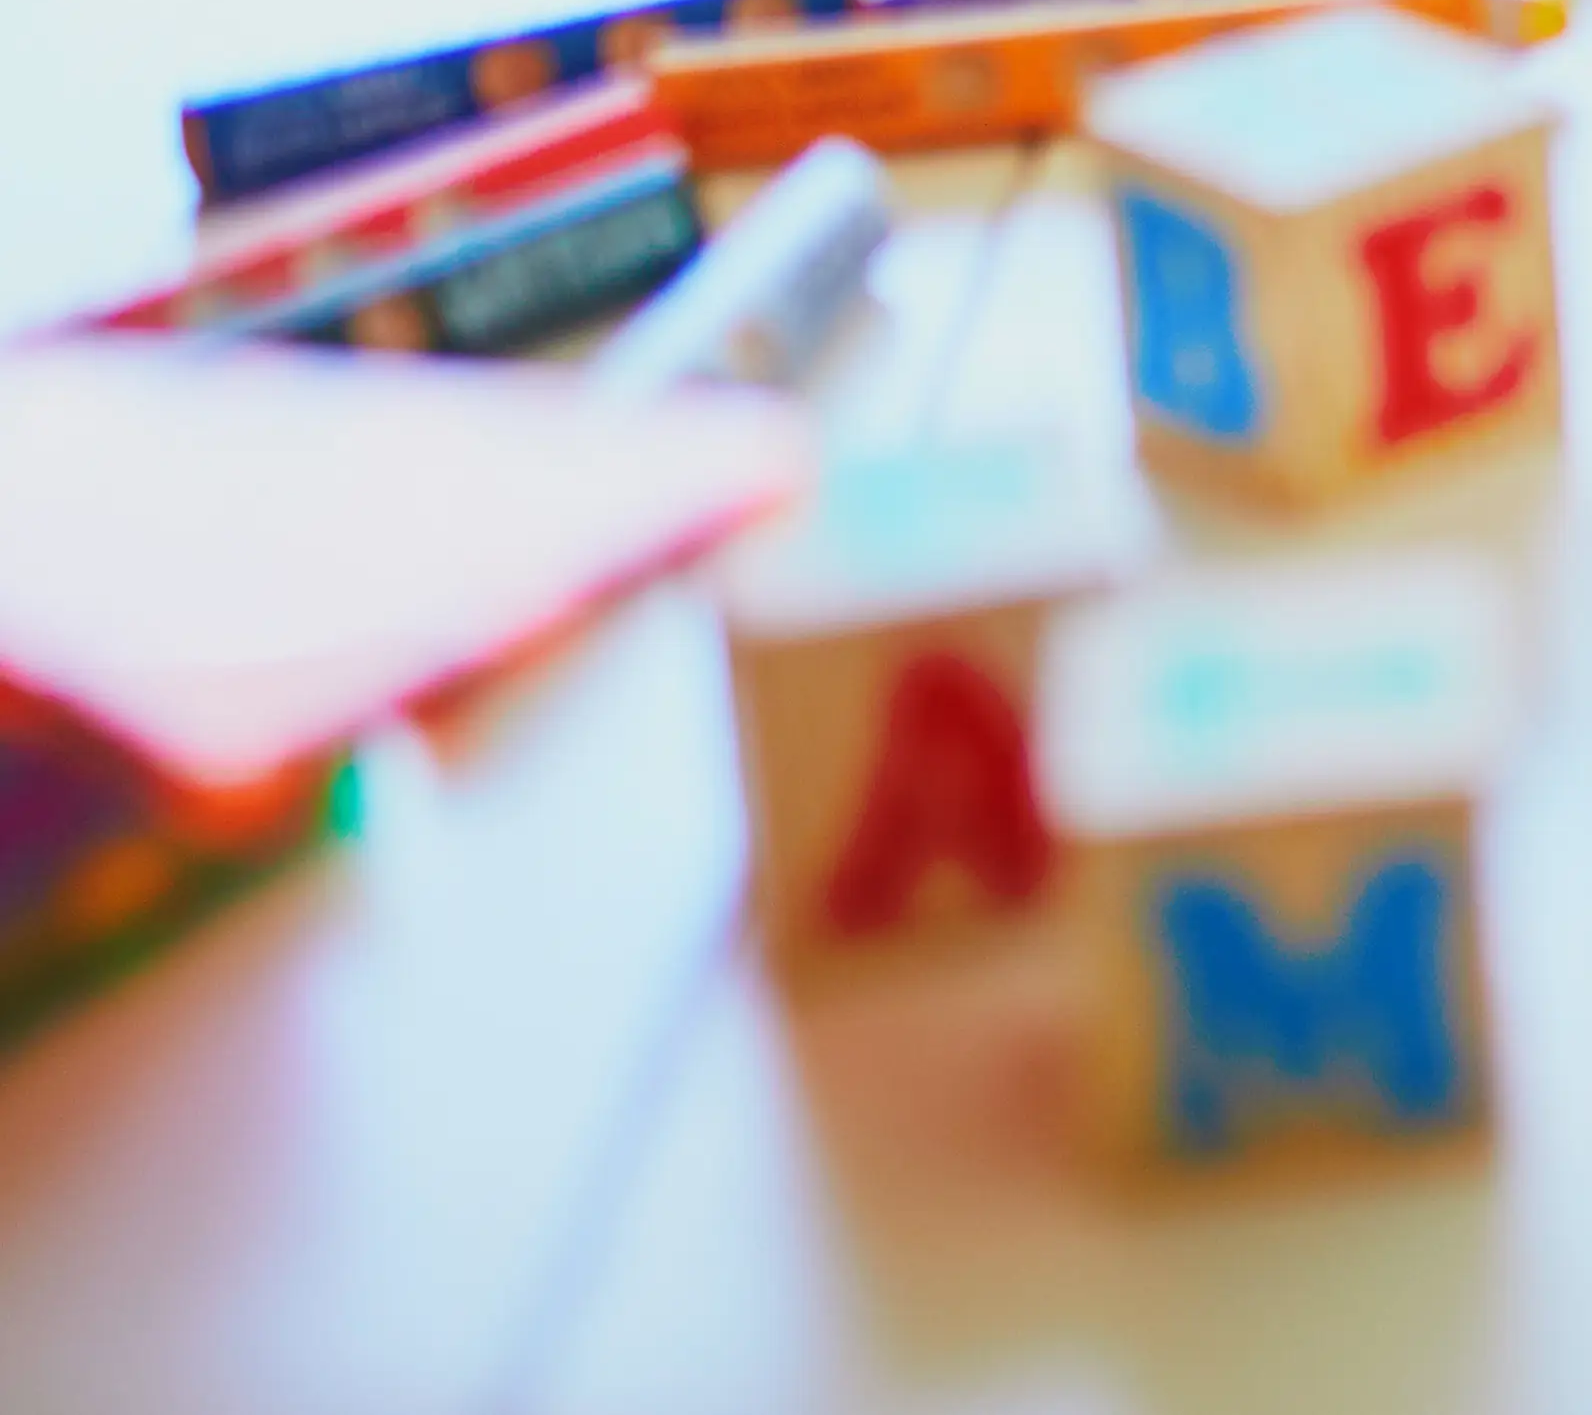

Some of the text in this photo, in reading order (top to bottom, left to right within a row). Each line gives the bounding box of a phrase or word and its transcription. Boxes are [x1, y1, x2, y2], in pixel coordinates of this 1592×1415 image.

[1360, 185, 1538, 447] E
[824, 646, 1055, 939] A
[1157, 853, 1464, 1151] M
